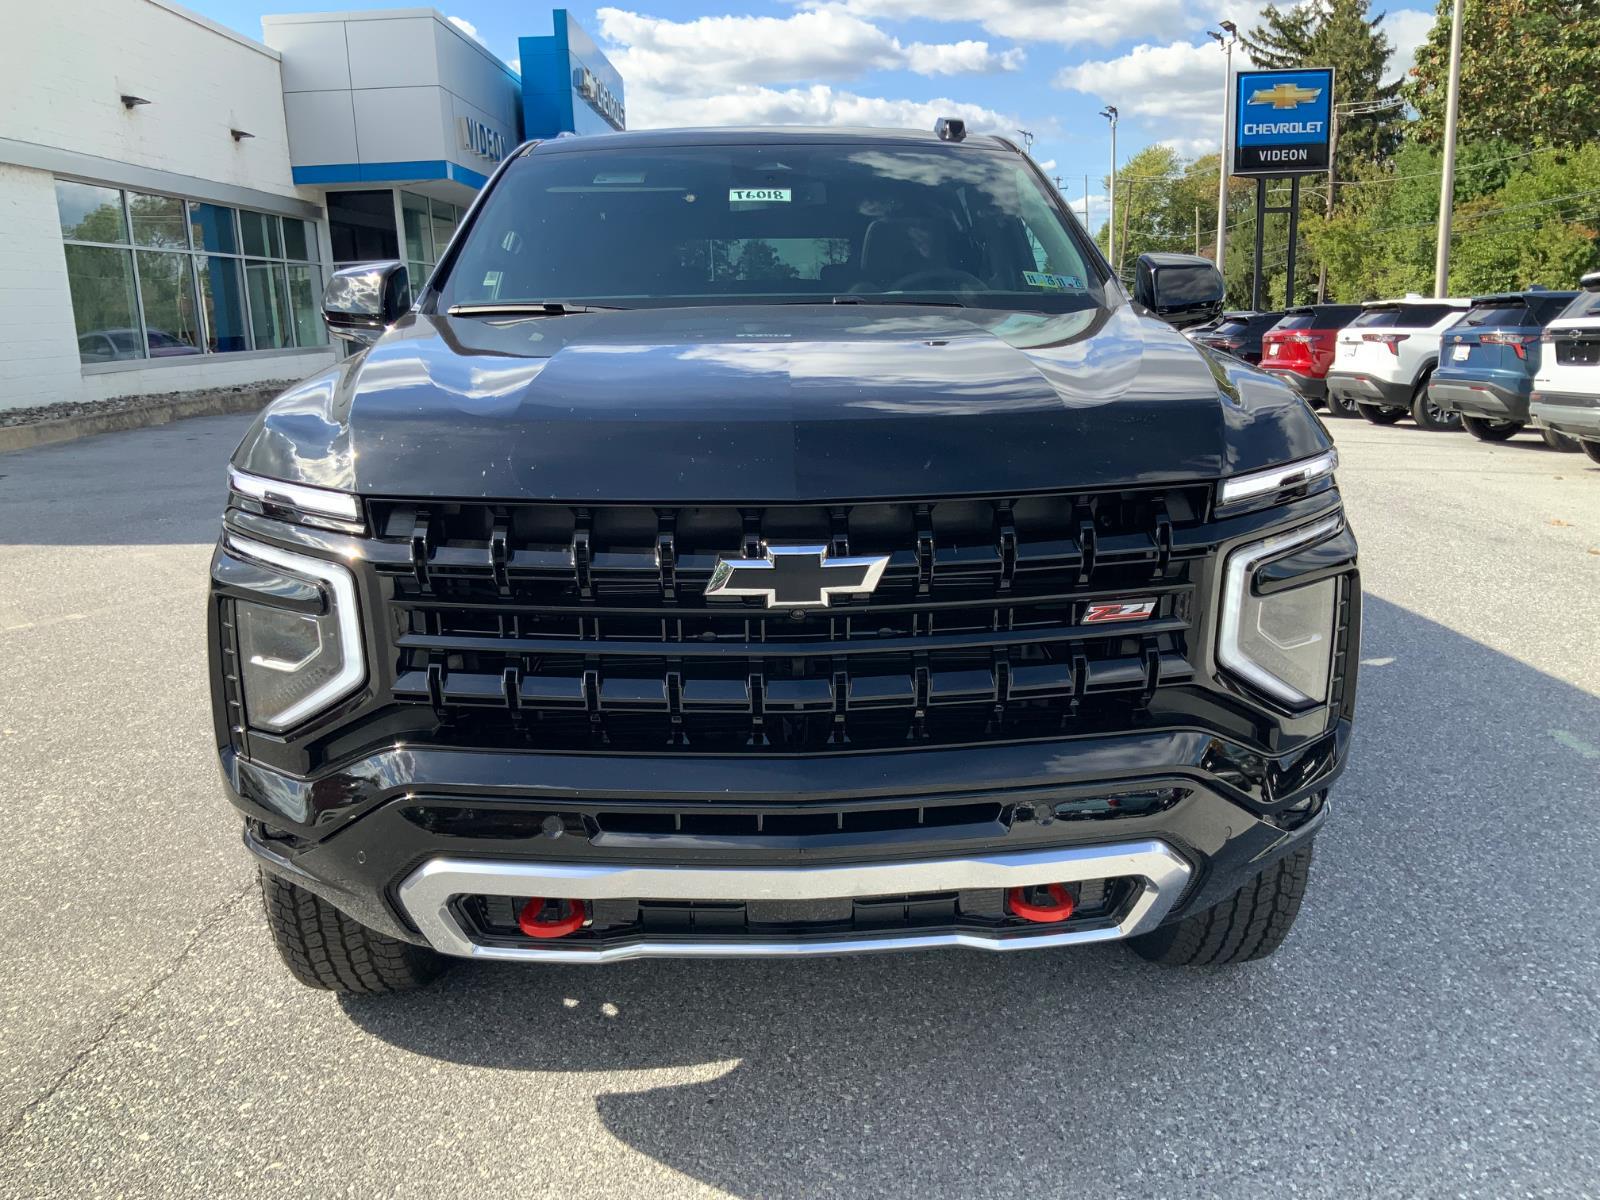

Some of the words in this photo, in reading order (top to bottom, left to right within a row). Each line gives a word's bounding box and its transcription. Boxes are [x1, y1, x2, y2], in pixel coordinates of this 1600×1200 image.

[1244, 121, 1324, 135] CHEVROLET
[1259, 149, 1308, 161] VIDEON
[733, 190, 784, 200] T6018
[1083, 602, 1156, 621] Z71
